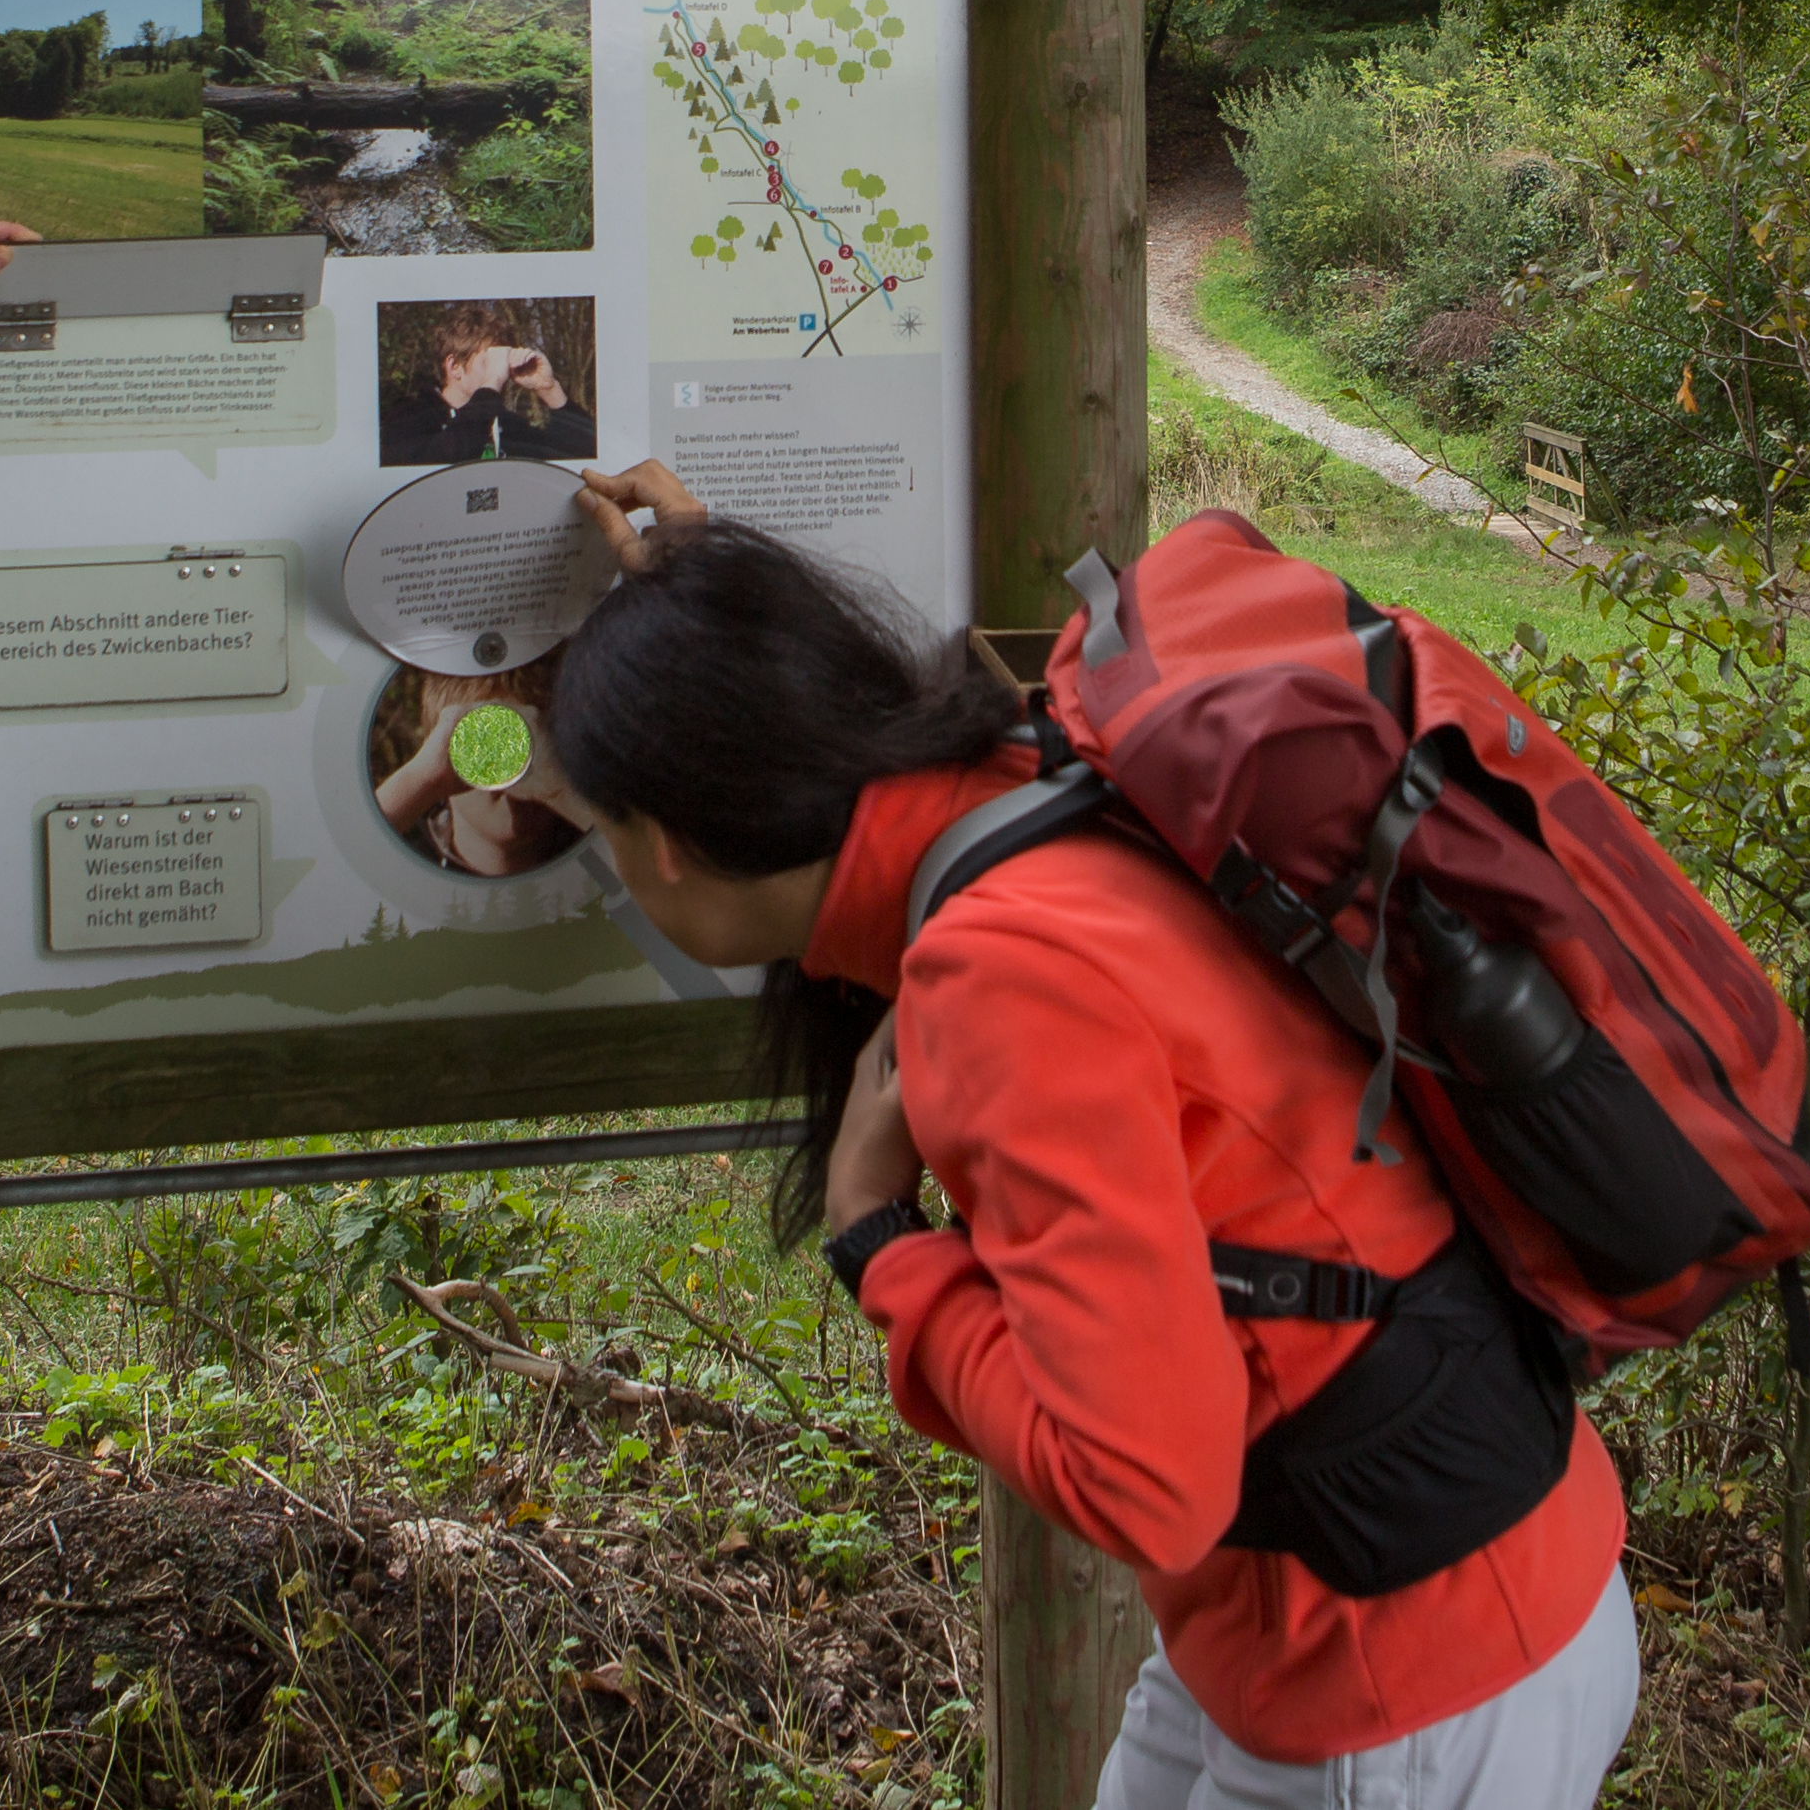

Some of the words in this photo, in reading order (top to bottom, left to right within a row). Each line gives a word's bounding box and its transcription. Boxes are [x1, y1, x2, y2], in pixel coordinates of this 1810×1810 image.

[685, 3, 717, 11] Infotafel
[721, 170, 754, 178] Infotafel
[821, 206, 851, 214] Infotafel
[831, 277, 849, 285] Info-
[831, 285, 846, 294] tafel
[850, 285, 856, 293] A
[733, 316, 797, 327] Wanderparkplatz
[747, 326, 790, 334] Weberhaus
[675, 435, 687, 443] Du
[690, 433, 713, 443] willst
[716, 432, 737, 442] noch
[740, 432, 762, 441] mehr
[765, 430, 799, 440] wissen?
[50, 612, 139, 632] Abschnitt
[145, 610, 209, 627] andere
[214, 608, 254, 625] Tier-
[62, 638, 96, 657] des
[101, 632, 252, 656] Zwickenbaches?
[85, 833, 149, 850] Warum
[155, 830, 177, 847] ist
[183, 828, 214, 845] der
[85, 853, 223, 876] Wiesenstreifen
[86, 882, 141, 902] direkt
[145, 884, 172, 899] am
[179, 877, 224, 896] Bach
[86, 907, 133, 926] nicht
[138, 903, 217, 928] gemäht?
